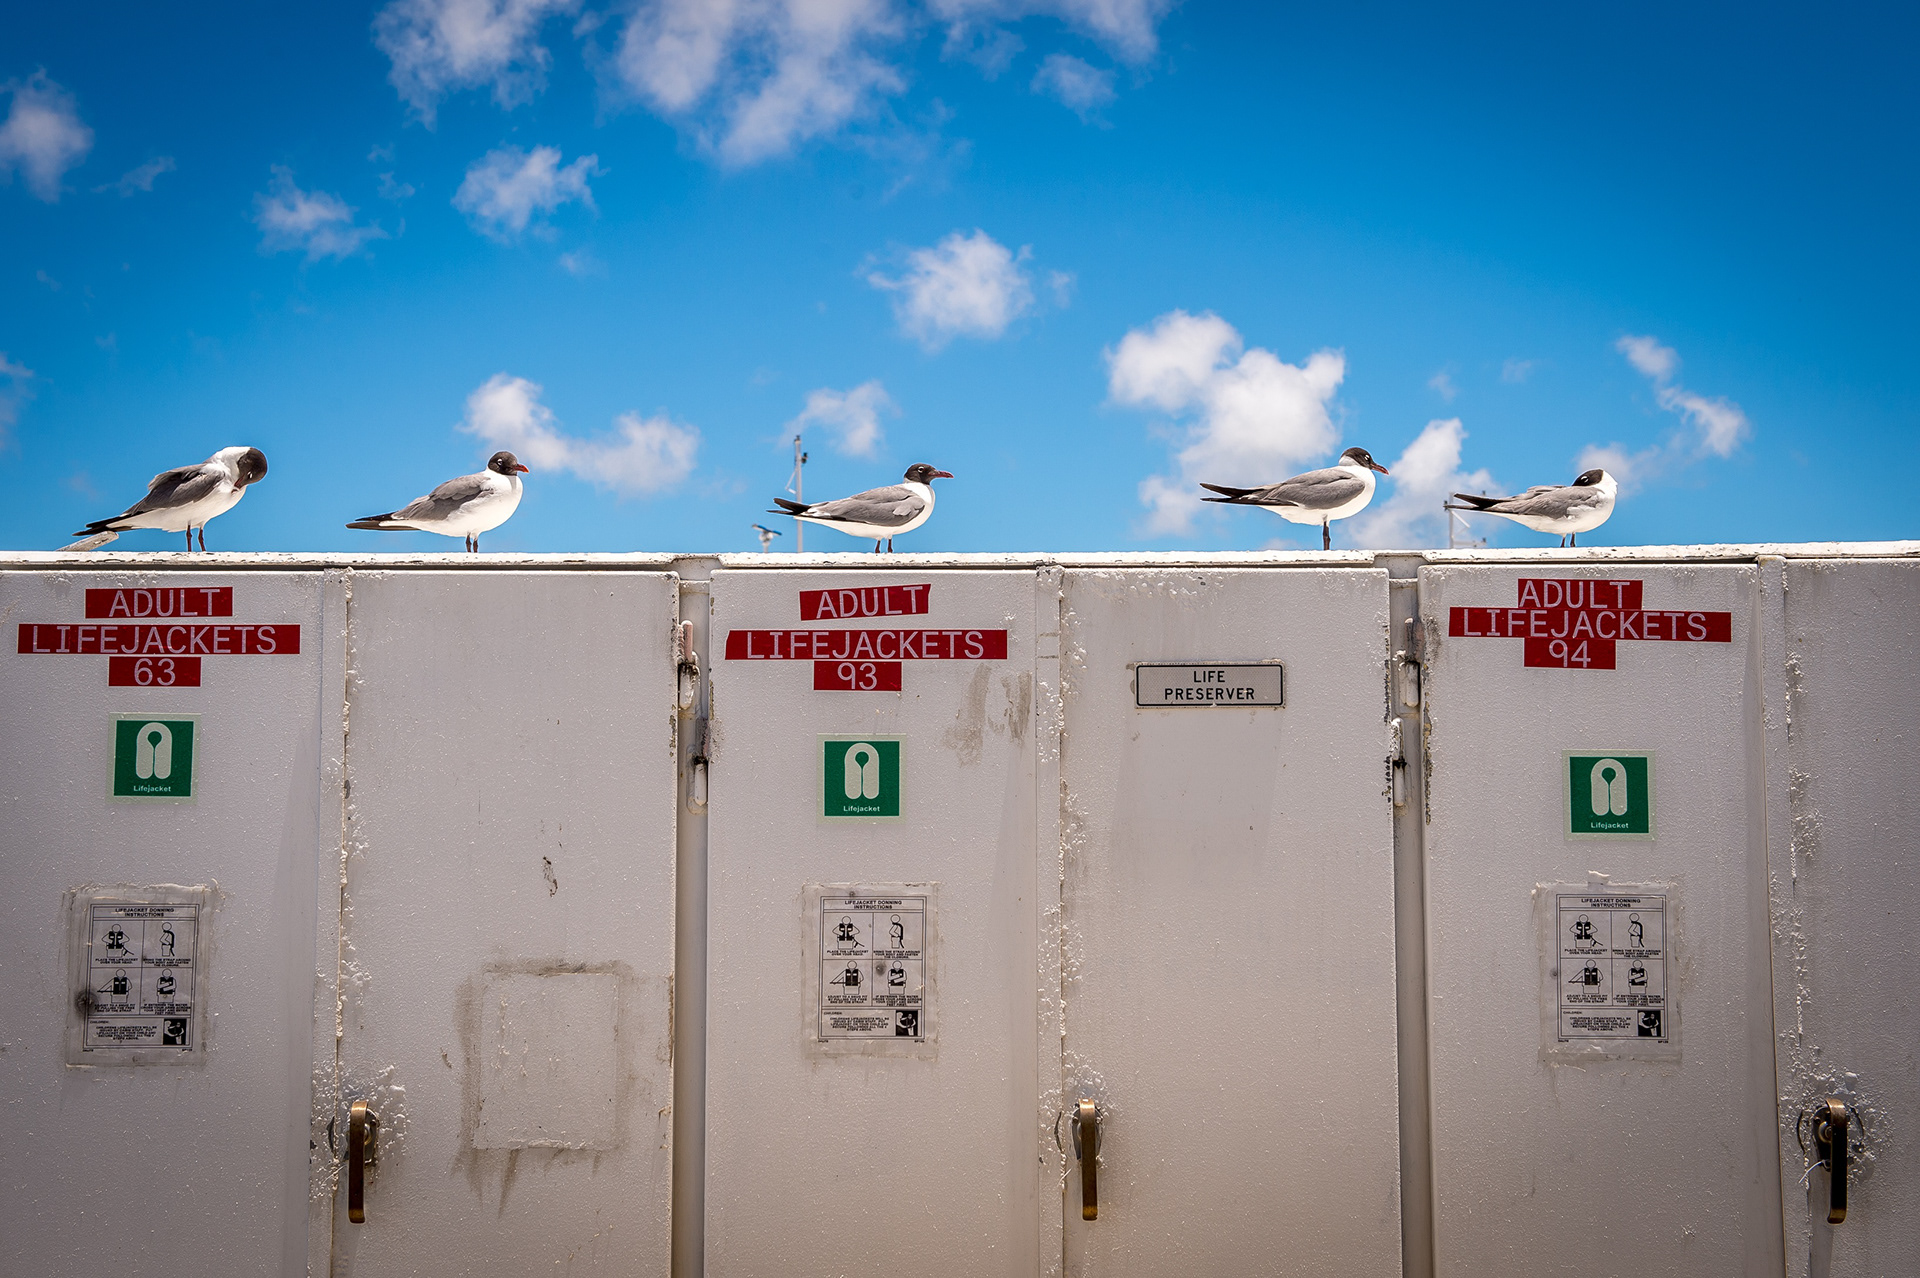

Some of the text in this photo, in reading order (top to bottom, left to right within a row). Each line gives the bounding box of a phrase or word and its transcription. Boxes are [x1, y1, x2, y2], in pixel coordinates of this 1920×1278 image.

[109, 588, 220, 617] ADULT
[816, 585, 923, 619] ADULT
[1519, 580, 1631, 609] ADULT
[1463, 609, 1707, 641] LIFEJACKETS
[32, 625, 277, 654] LIFEJACKETS
[747, 631, 984, 659] LIFEJACKETS
[1549, 639, 1591, 668] 94
[134, 658, 176, 686] 63
[837, 662, 878, 690] 93
[1193, 670, 1226, 683] LIFE
[1164, 687, 1255, 700] PRESERVER
[133, 784, 172, 794] Lifejacket
[843, 804, 881, 814] Lifejacket
[1590, 821, 1629, 831] Lifejacket
